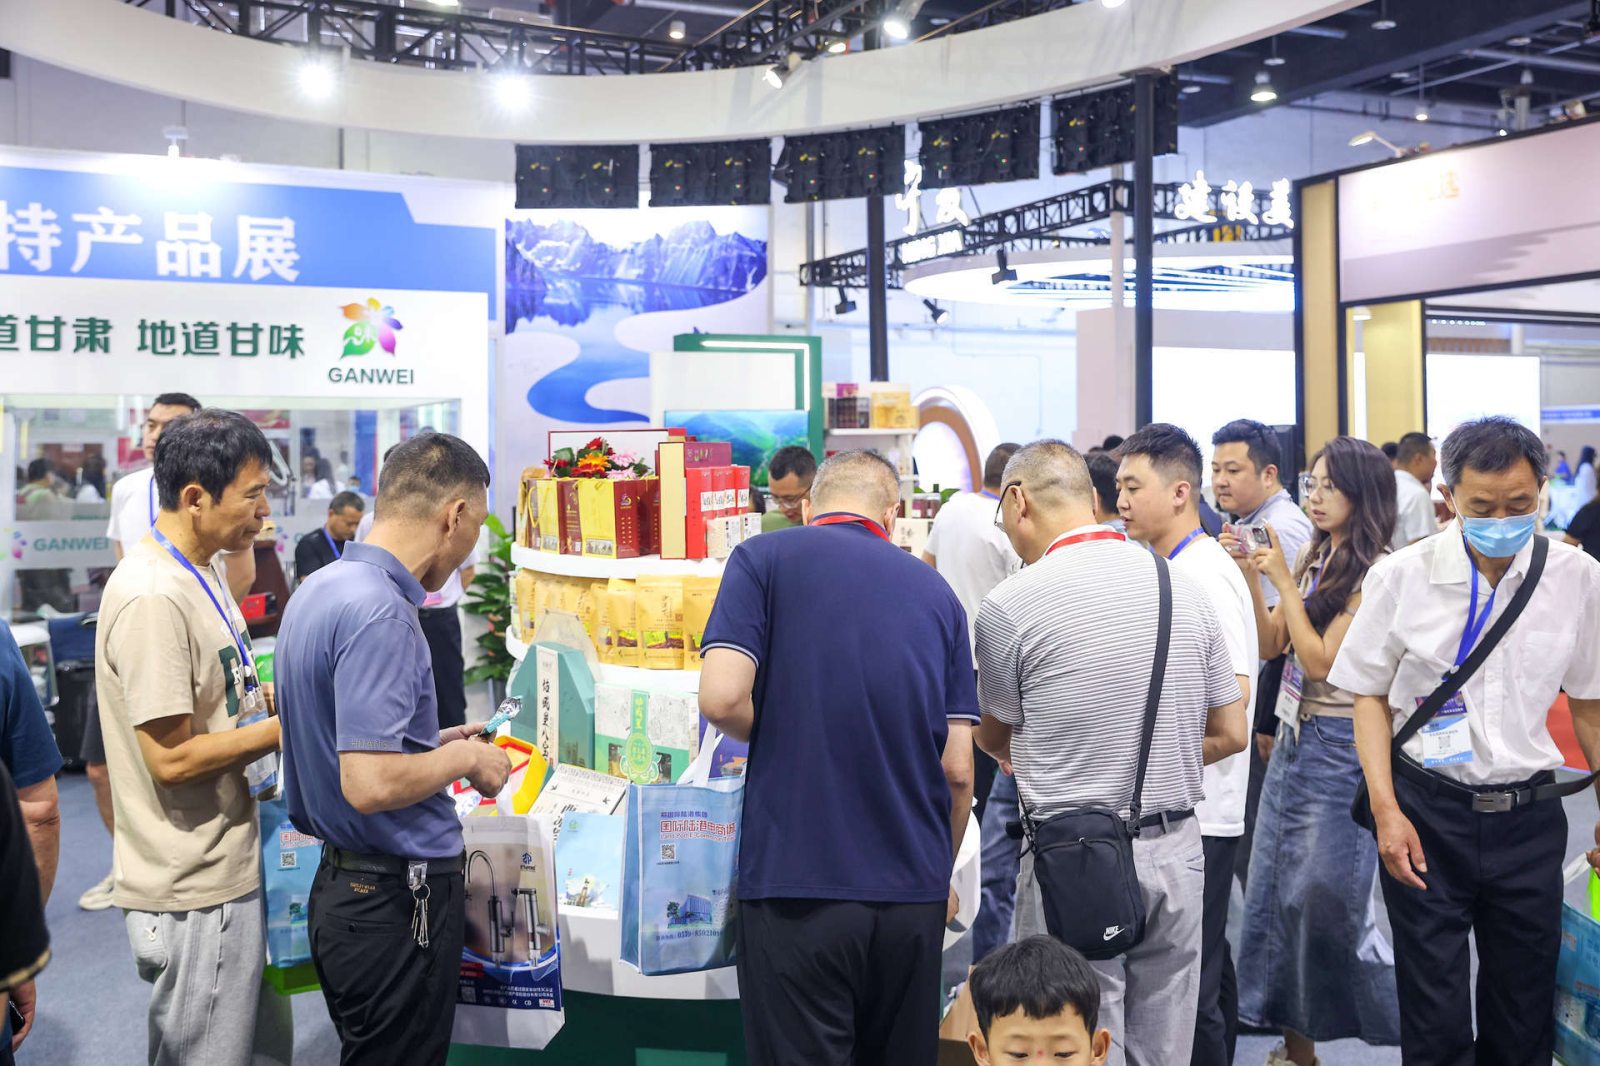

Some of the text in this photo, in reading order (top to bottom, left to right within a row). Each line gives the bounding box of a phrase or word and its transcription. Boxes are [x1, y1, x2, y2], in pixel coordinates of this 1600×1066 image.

[0, 199, 301, 283] 特产品展
[137, 318, 304, 359] 地道甘味
[328, 367, 414, 384] GANWEI
[33, 537, 109, 552] GANWEI
[1105, 925, 1119, 935] NIKE
